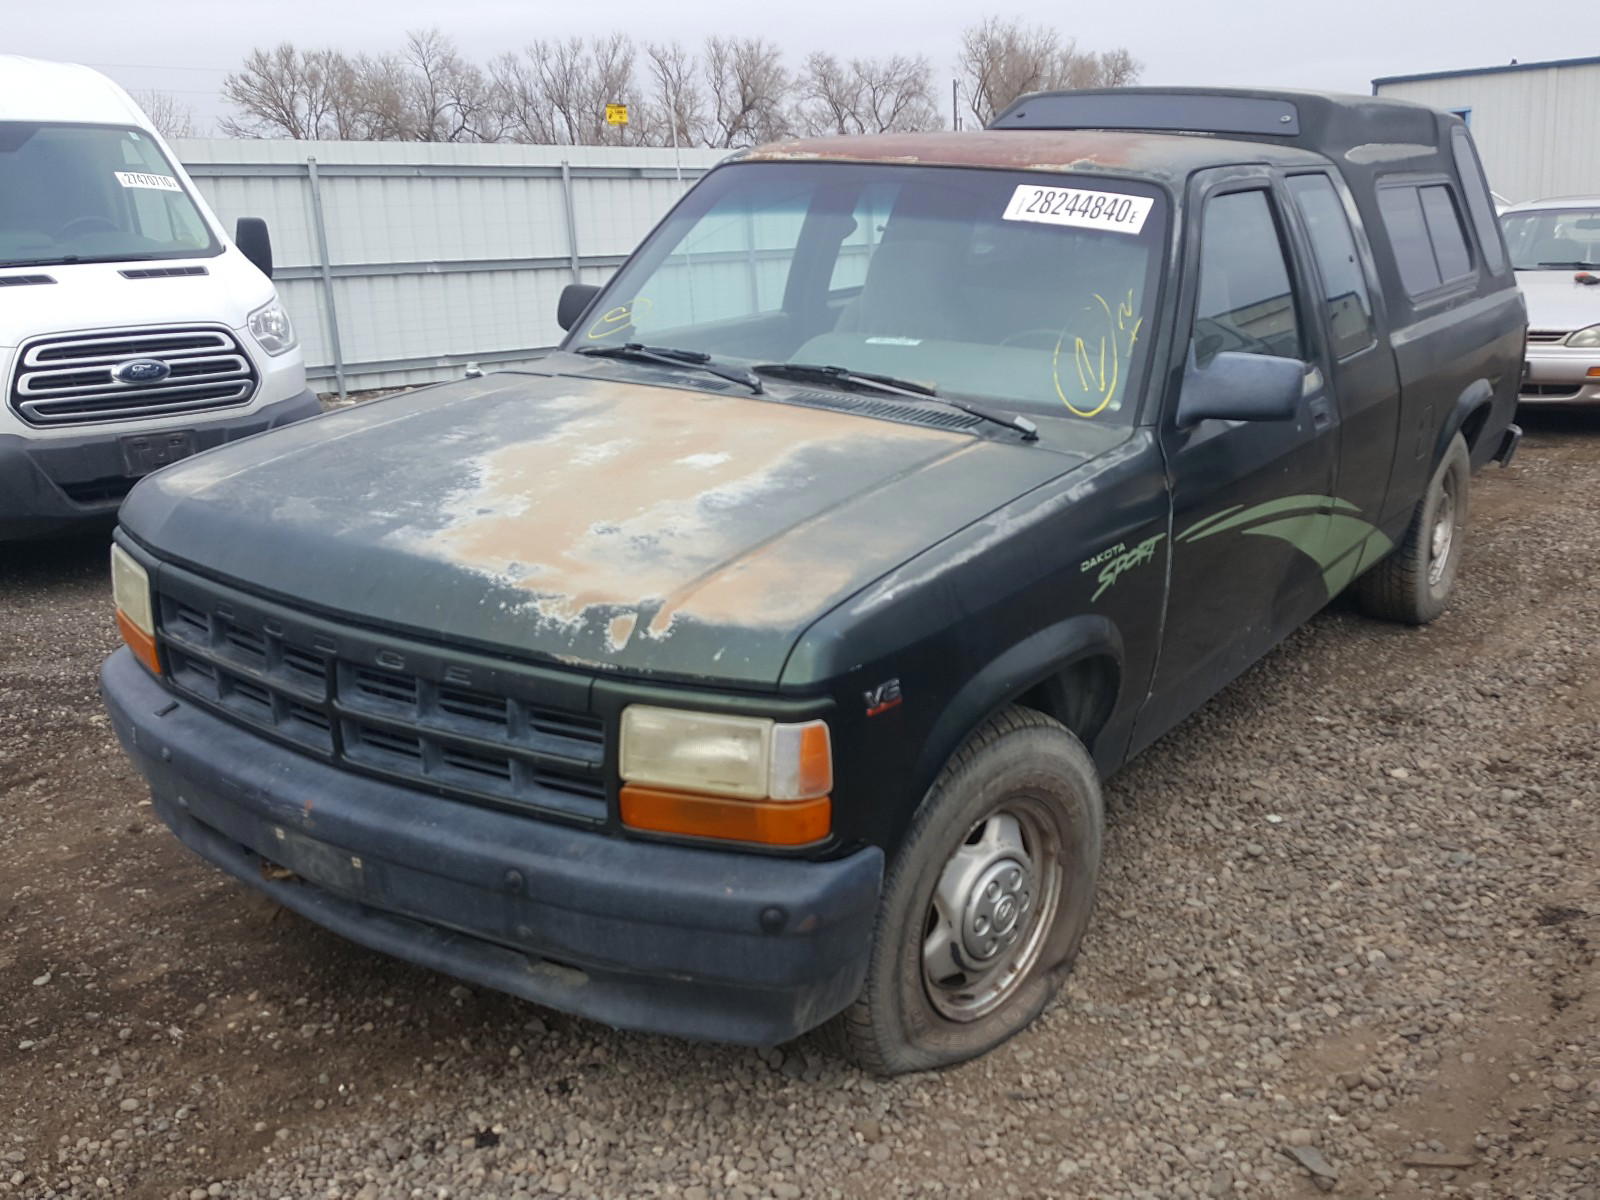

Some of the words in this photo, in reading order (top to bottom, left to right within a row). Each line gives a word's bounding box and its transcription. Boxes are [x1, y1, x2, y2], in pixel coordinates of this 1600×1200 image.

[123, 173, 172, 188] 27470710
[1026, 190, 1132, 223] 28244840
[1080, 542, 1127, 573] DAKOTA
[215, 600, 473, 686] DODGE
[863, 678, 901, 706] V6
